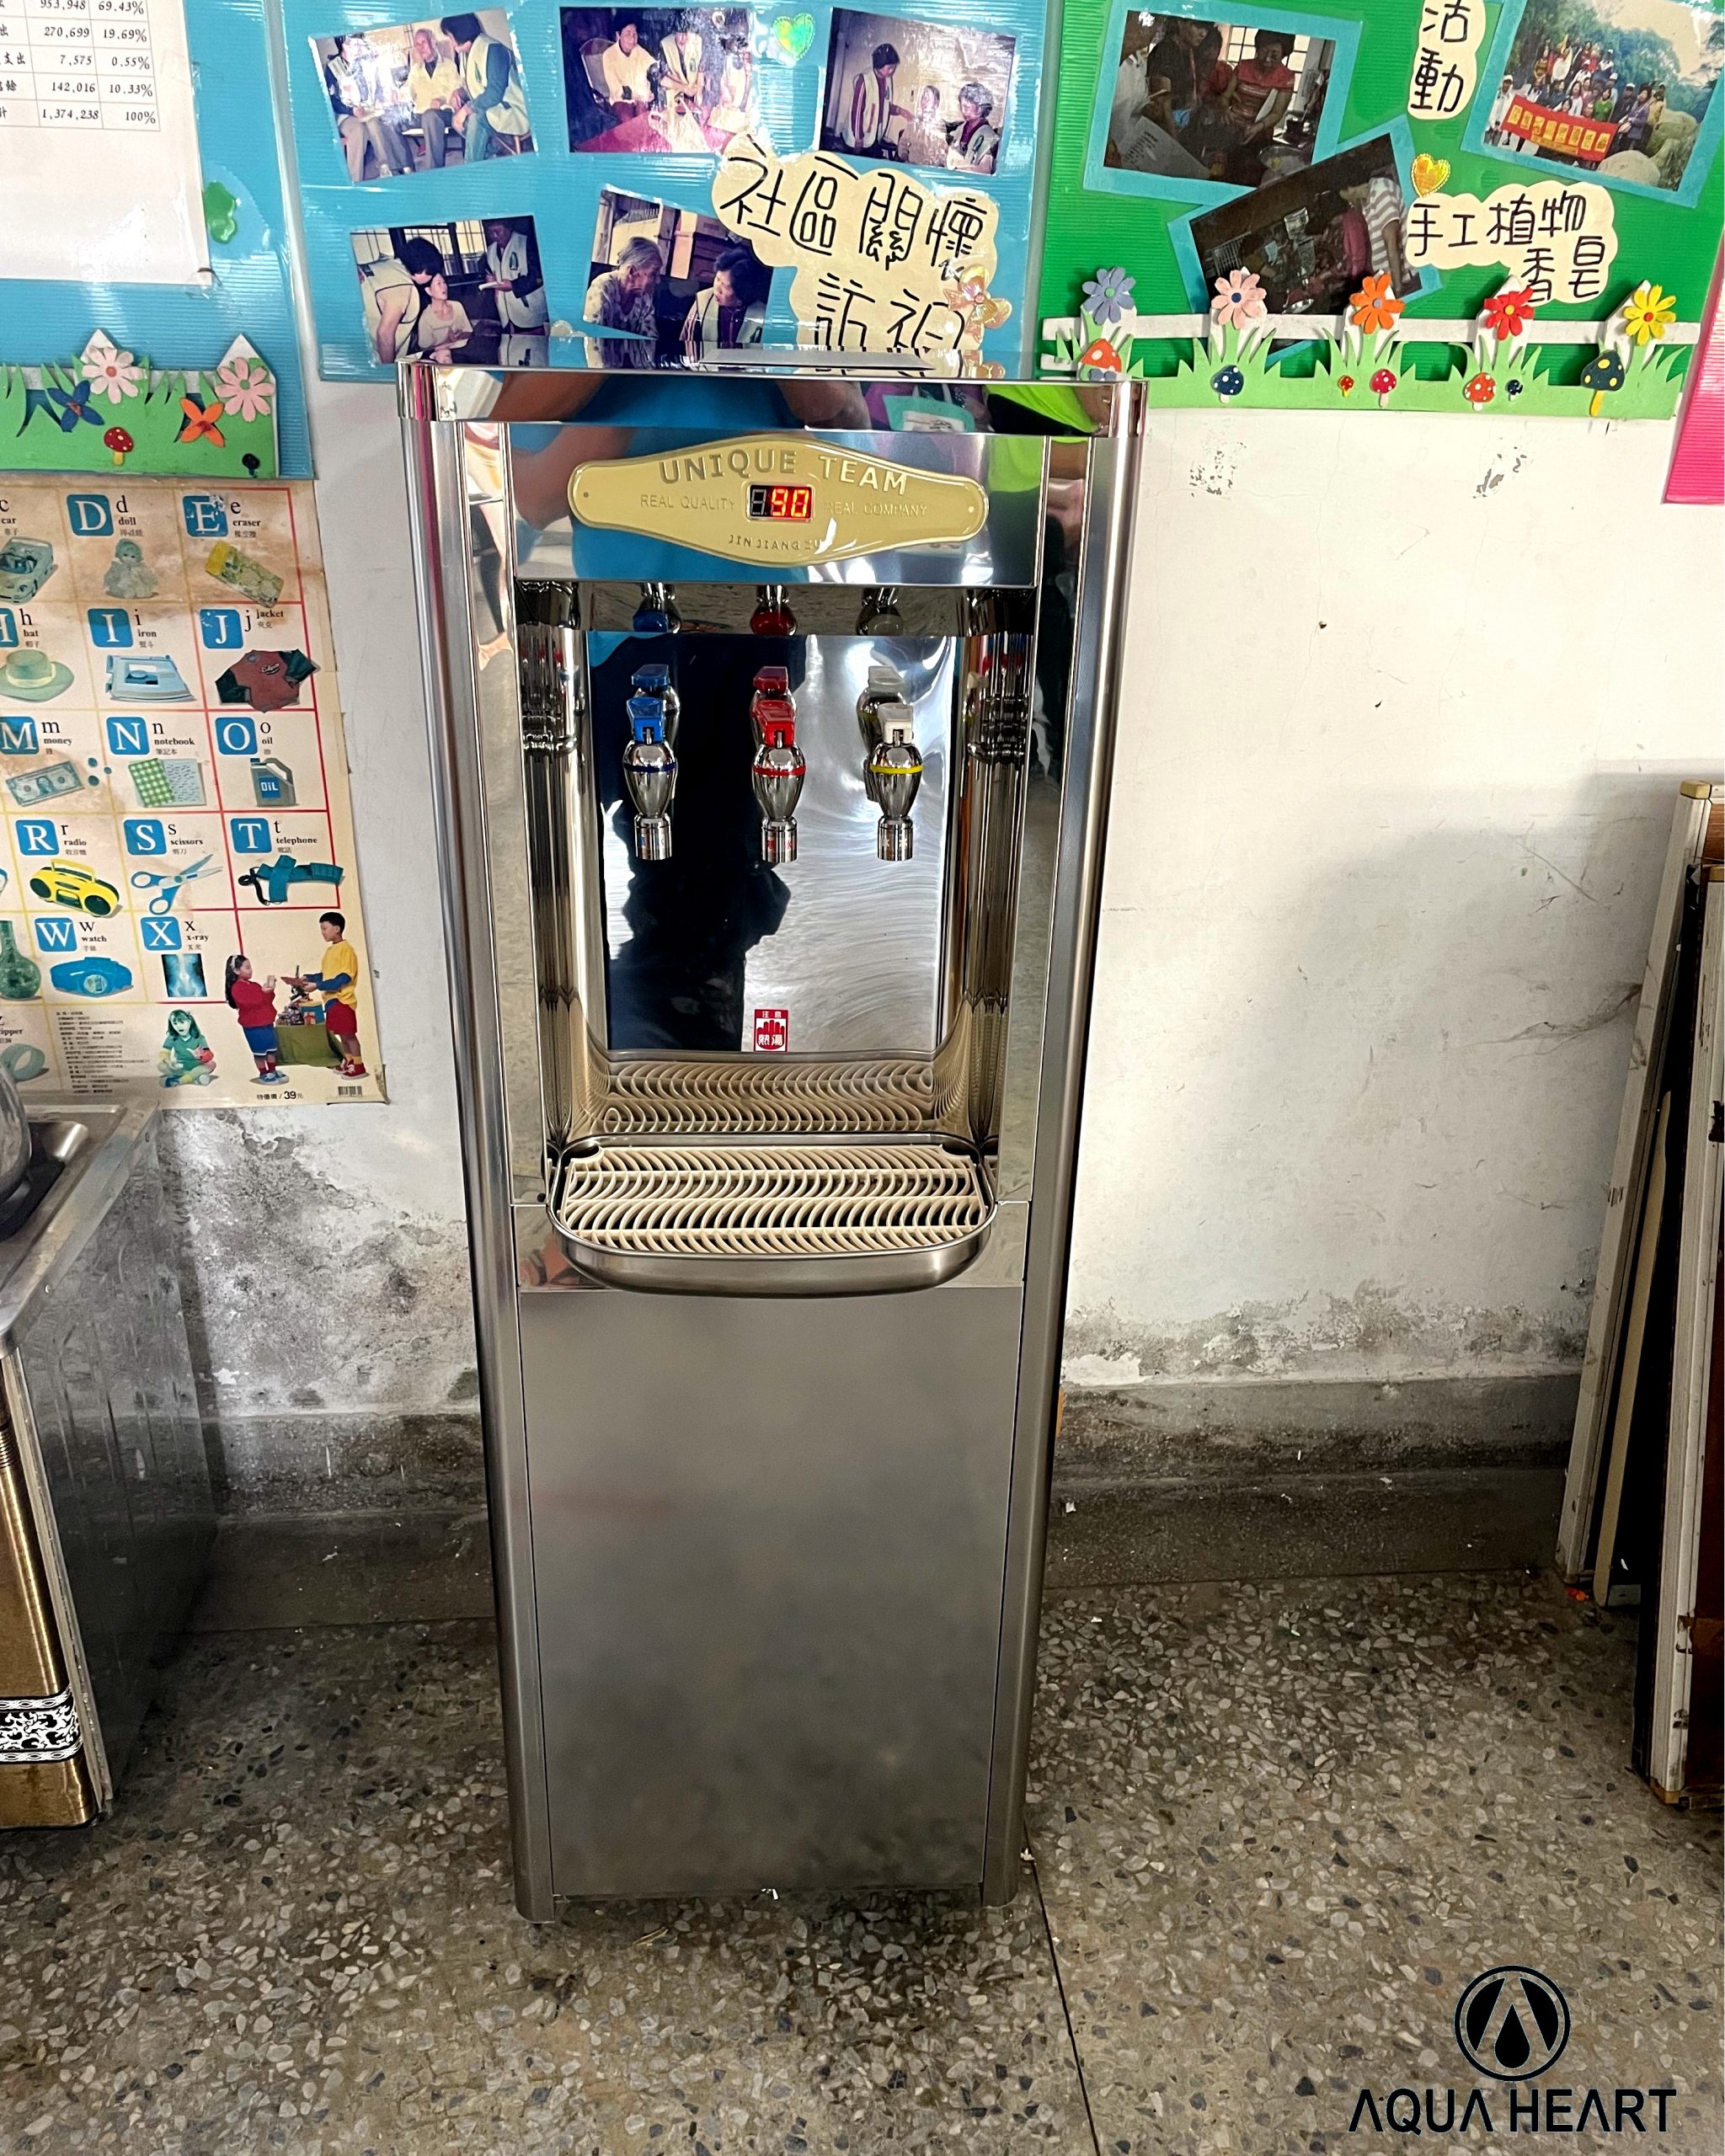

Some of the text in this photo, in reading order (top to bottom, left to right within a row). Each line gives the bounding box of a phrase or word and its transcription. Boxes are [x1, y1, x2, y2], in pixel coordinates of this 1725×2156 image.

[40, 0, 144, 14] 953,948 69.43%
[44, 27, 90, 38] 270,699
[103, 29, 147, 42] 19.69%
[60, 55, 92, 66] 7,575
[111, 57, 150, 70] 0.55%
[1411, 0, 1471, 112] 活動
[52, 82, 95, 93] 142,016
[109, 84, 153, 97] 10.33%
[42, 109, 99, 120] 1,374,238
[126, 112, 156, 124] 100%
[1408, 190, 1586, 256] 手工植物
[1521, 236, 1605, 302] 香皂
[659, 448, 908, 495] UNIQUE TEAM
[74, 495, 128, 531] D d
[640, 494, 735, 510] REAL QUALITY
[772, 488, 809, 517] 90
[825, 502, 927, 516] REAL COMPANY
[119, 517, 136, 526] doll
[191, 501, 241, 531] E e
[19, 608, 33, 626] h
[102, 609, 142, 643] I i
[215, 610, 252, 644] J j
[256, 610, 284, 618] jacket
[137, 628, 157, 638] iron
[0, 721, 61, 750] M m
[112, 722, 164, 750] N n
[154, 737, 195, 745] notebook
[222, 722, 271, 750] O o
[24, 825, 68, 851] R r
[136, 824, 177, 851] S s
[238, 819, 281, 849] T t
[276, 836, 318, 846] telephone
[36, 921, 95, 947] W w
[146, 921, 196, 947] X x
